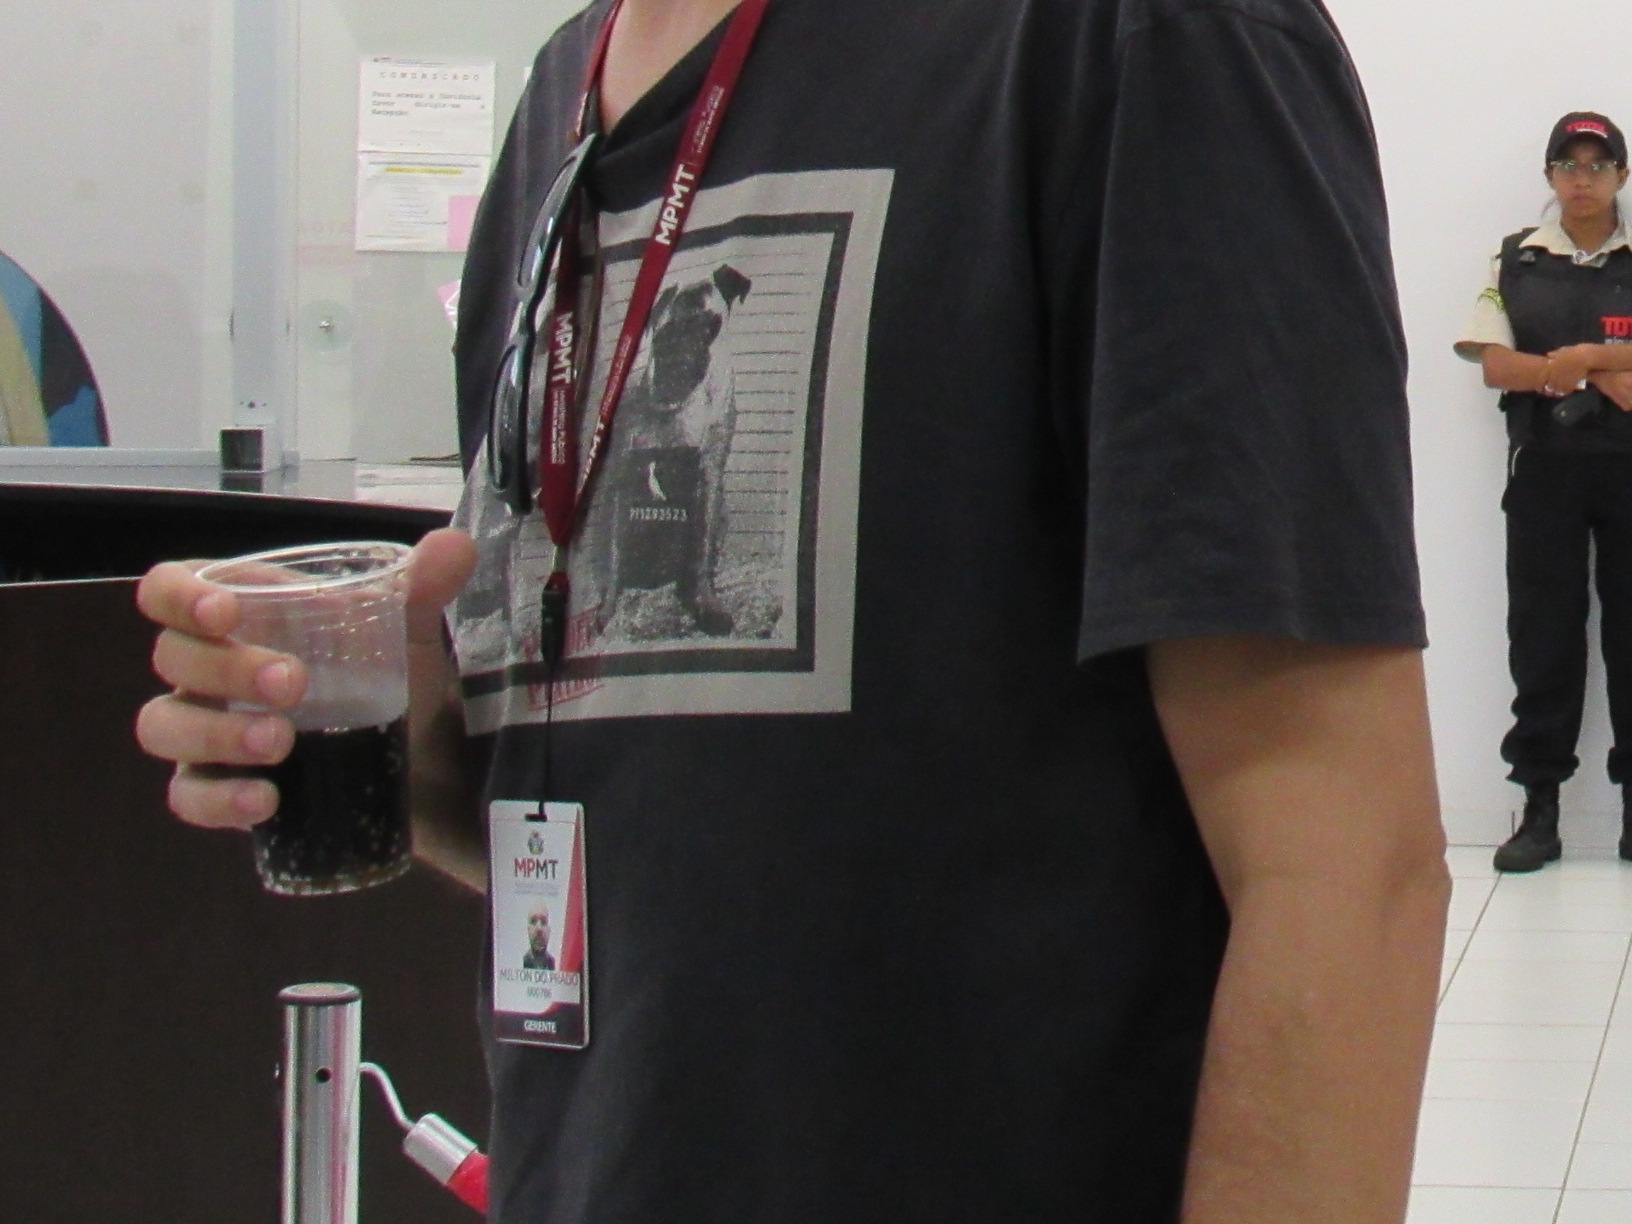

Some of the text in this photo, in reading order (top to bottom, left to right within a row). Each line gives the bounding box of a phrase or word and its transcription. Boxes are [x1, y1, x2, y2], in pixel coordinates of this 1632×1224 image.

[655, 163, 695, 245] MPMT
[552, 312, 573, 385] MPMT
[514, 857, 559, 879] MPMT
[523, 1019, 557, 1034] GERENTE
